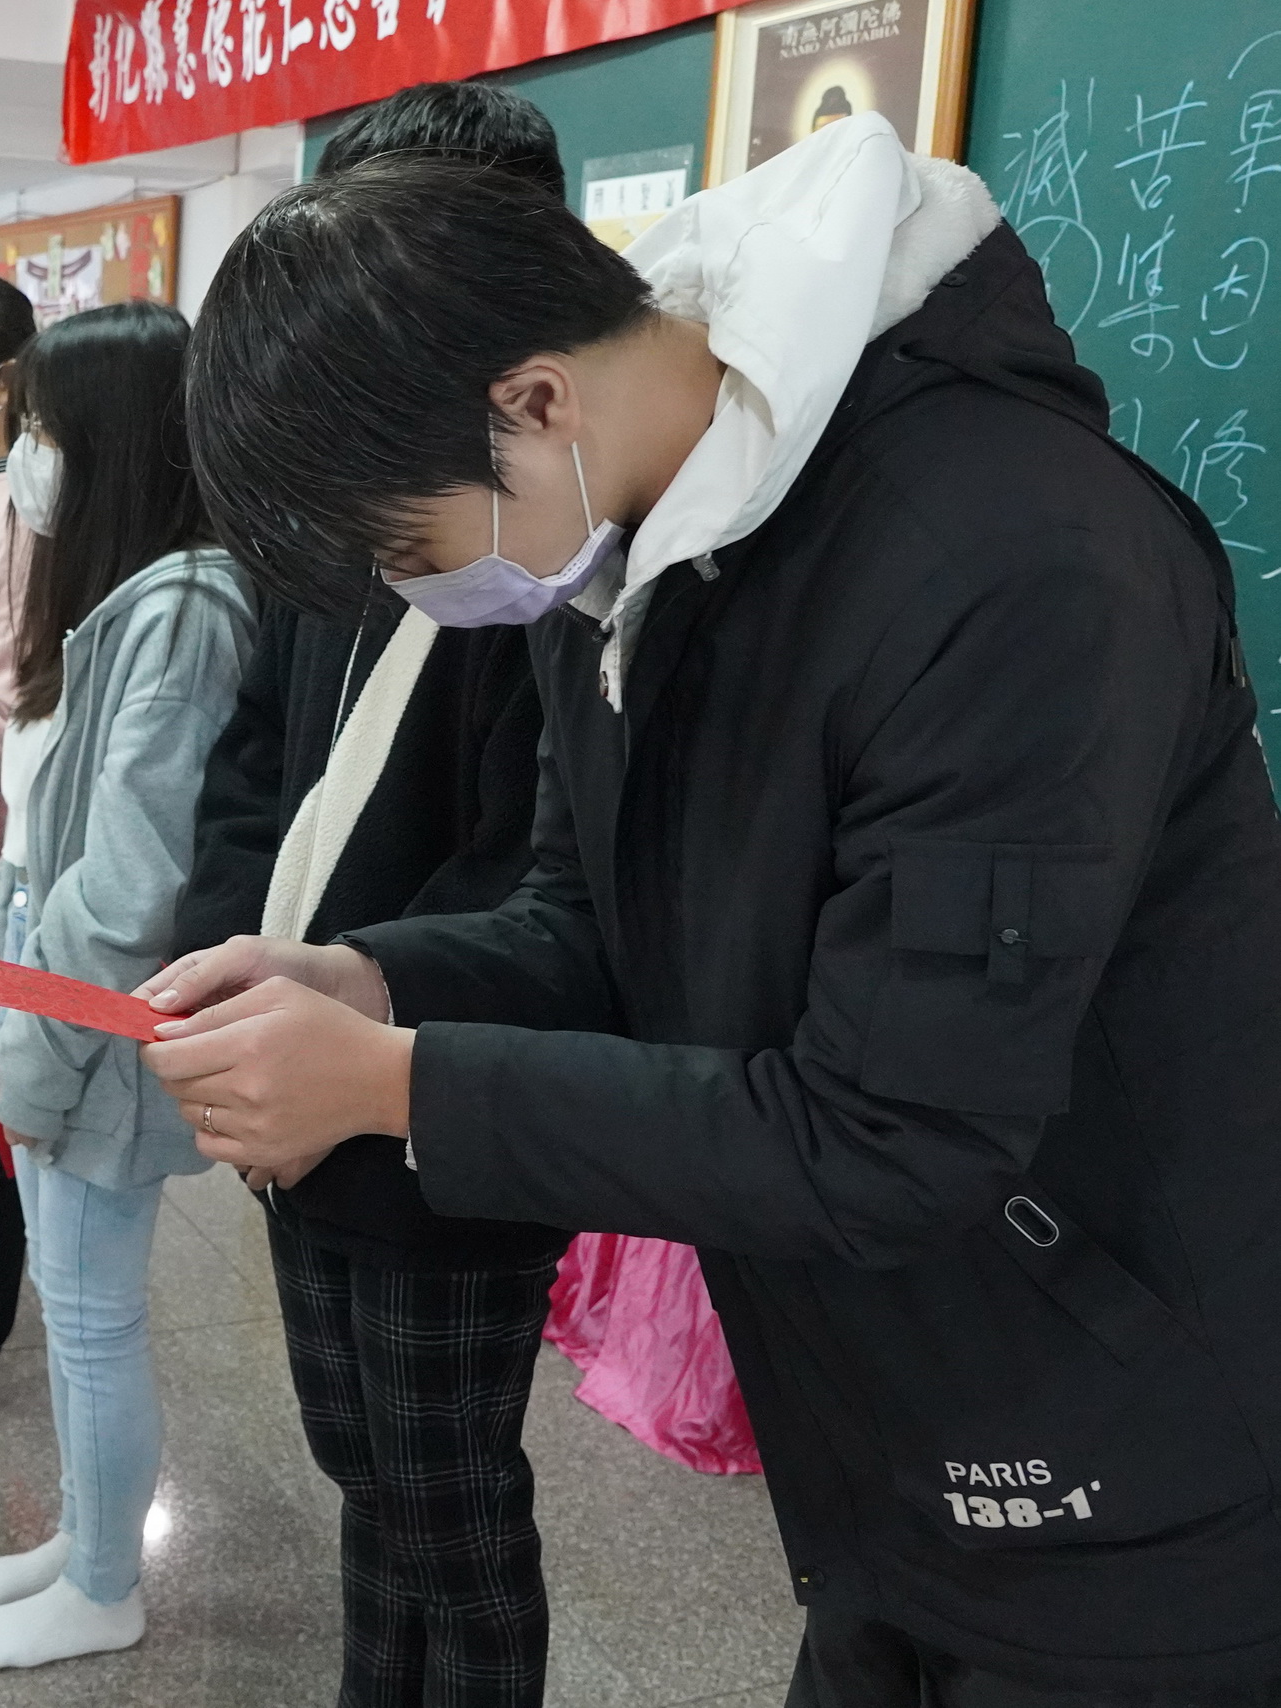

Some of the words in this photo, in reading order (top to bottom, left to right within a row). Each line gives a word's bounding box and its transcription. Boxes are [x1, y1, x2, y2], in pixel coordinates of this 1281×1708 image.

[781, 0, 901, 46] 南無阿彌陀佛
[780, 41, 820, 58] NAMO
[825, 24, 900, 50] AMITABHA
[944, 1459, 1052, 1488] PARIS
